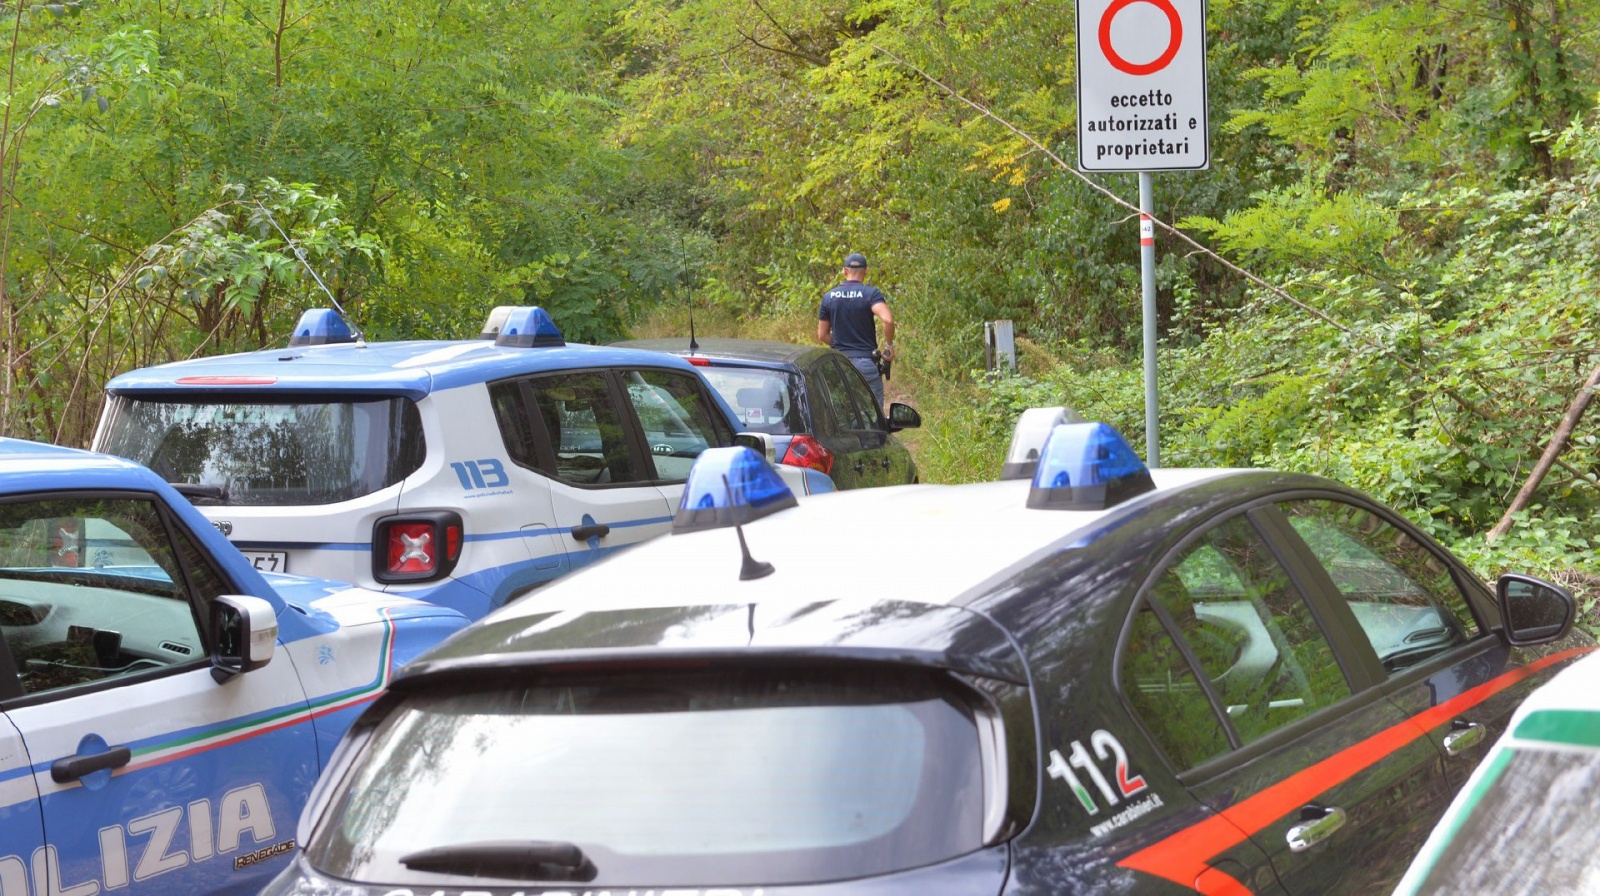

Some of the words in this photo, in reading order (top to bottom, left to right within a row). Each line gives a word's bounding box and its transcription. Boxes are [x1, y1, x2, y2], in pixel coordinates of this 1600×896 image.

[1110, 89, 1173, 107] eccetto
[1087, 112, 1177, 132] autorizzati
[1188, 117, 1197, 130] e
[1096, 137, 1189, 160] proprietari
[830, 290, 863, 299] POLIZIA
[450, 459, 509, 490] 113
[1046, 729, 1148, 816] 112
[233, 838, 295, 870] RENEGADE
